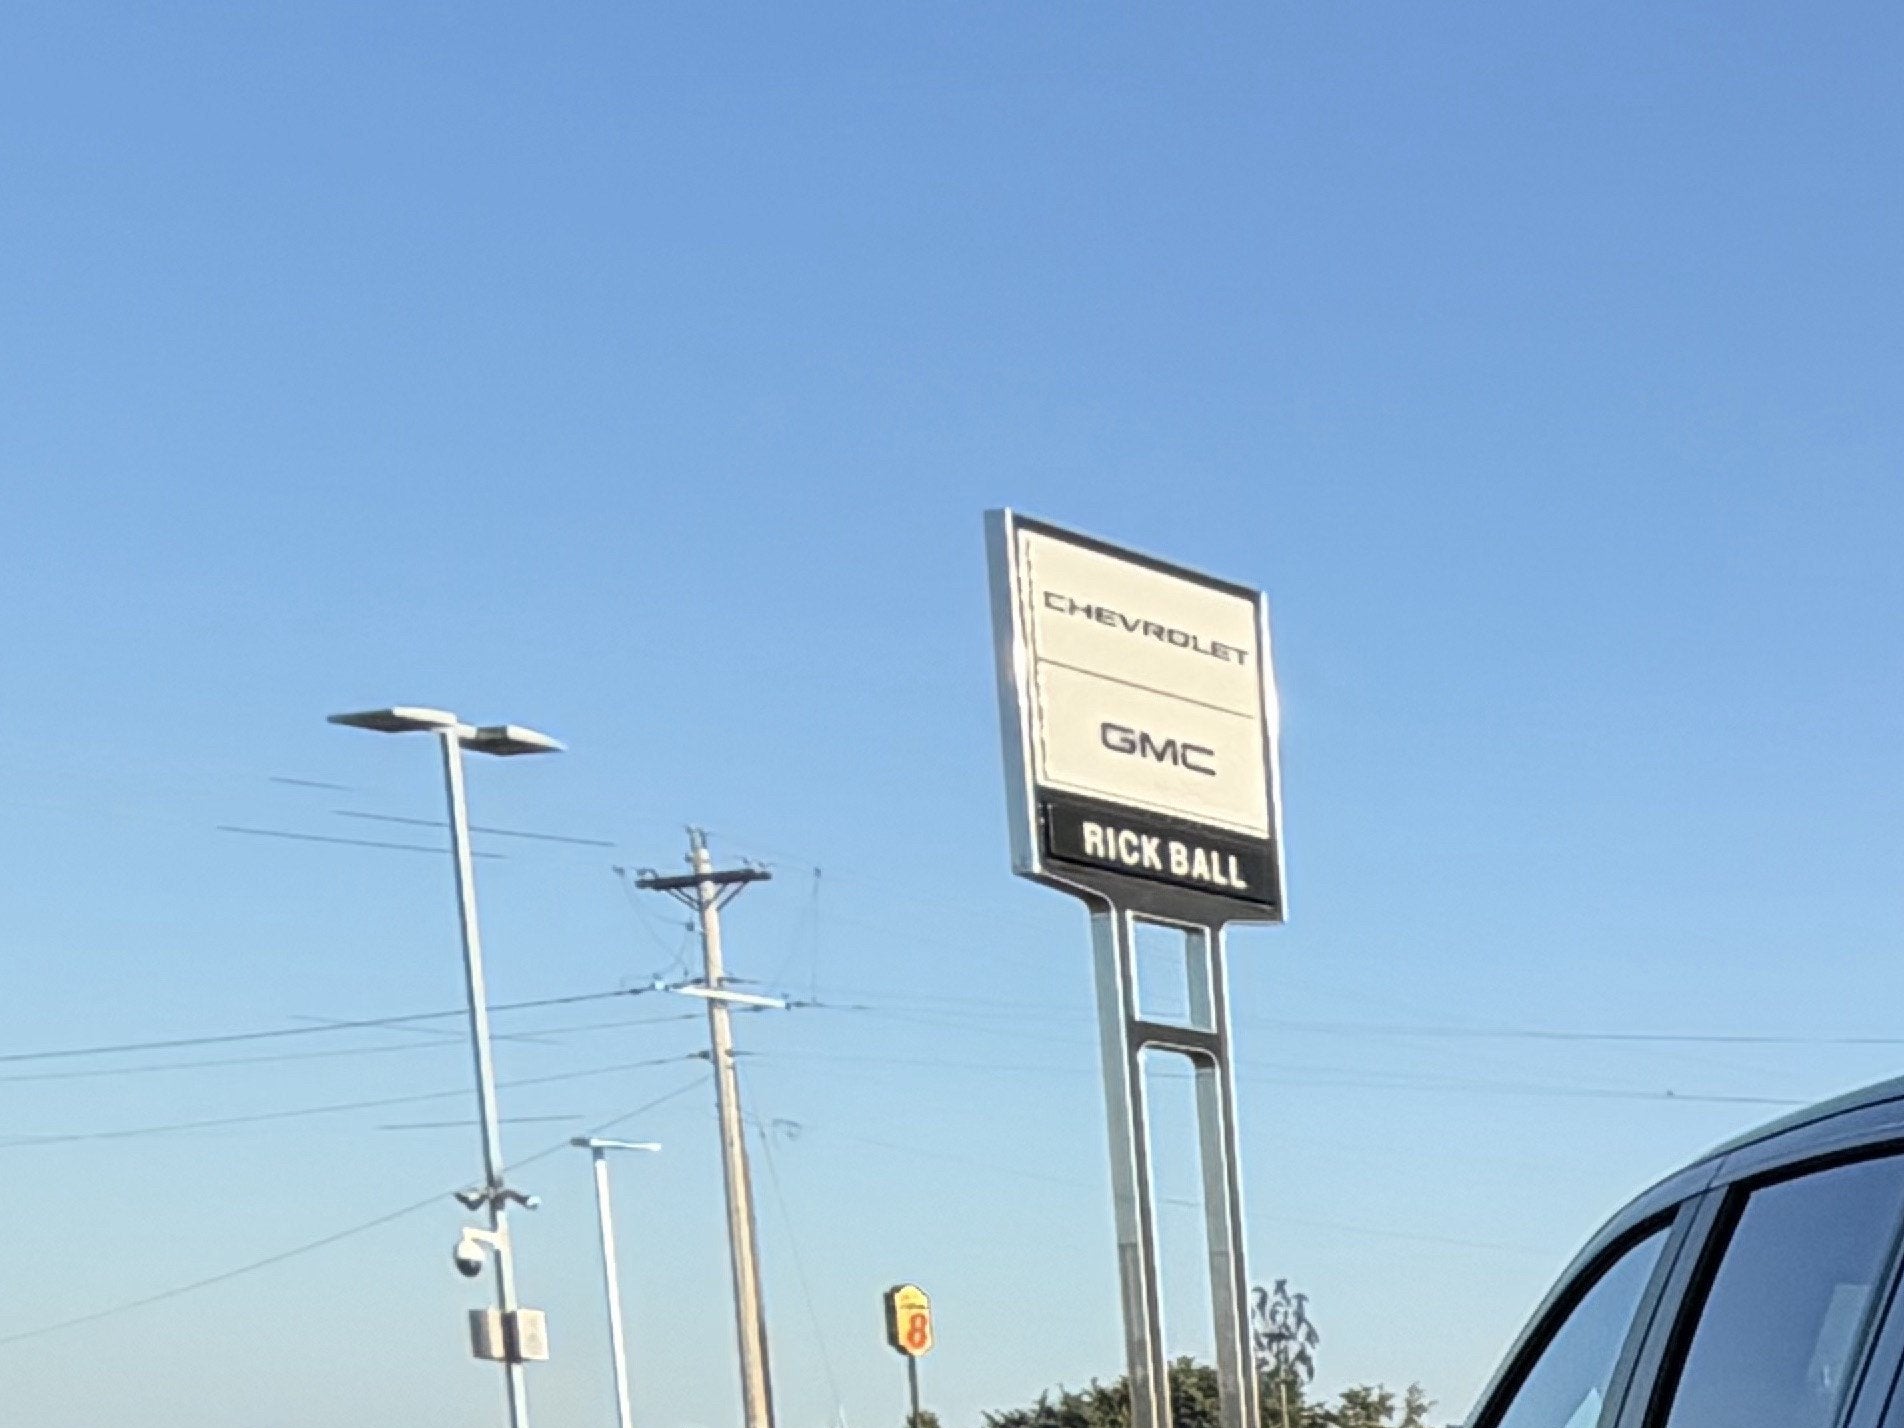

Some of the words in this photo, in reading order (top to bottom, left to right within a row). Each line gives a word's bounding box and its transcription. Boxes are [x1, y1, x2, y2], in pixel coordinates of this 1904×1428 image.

[1043, 590, 1249, 667] CHEVROLET
[1100, 721, 1217, 777] GMC
[1082, 820, 1163, 870] RICK
[1168, 841, 1247, 891] BALL
